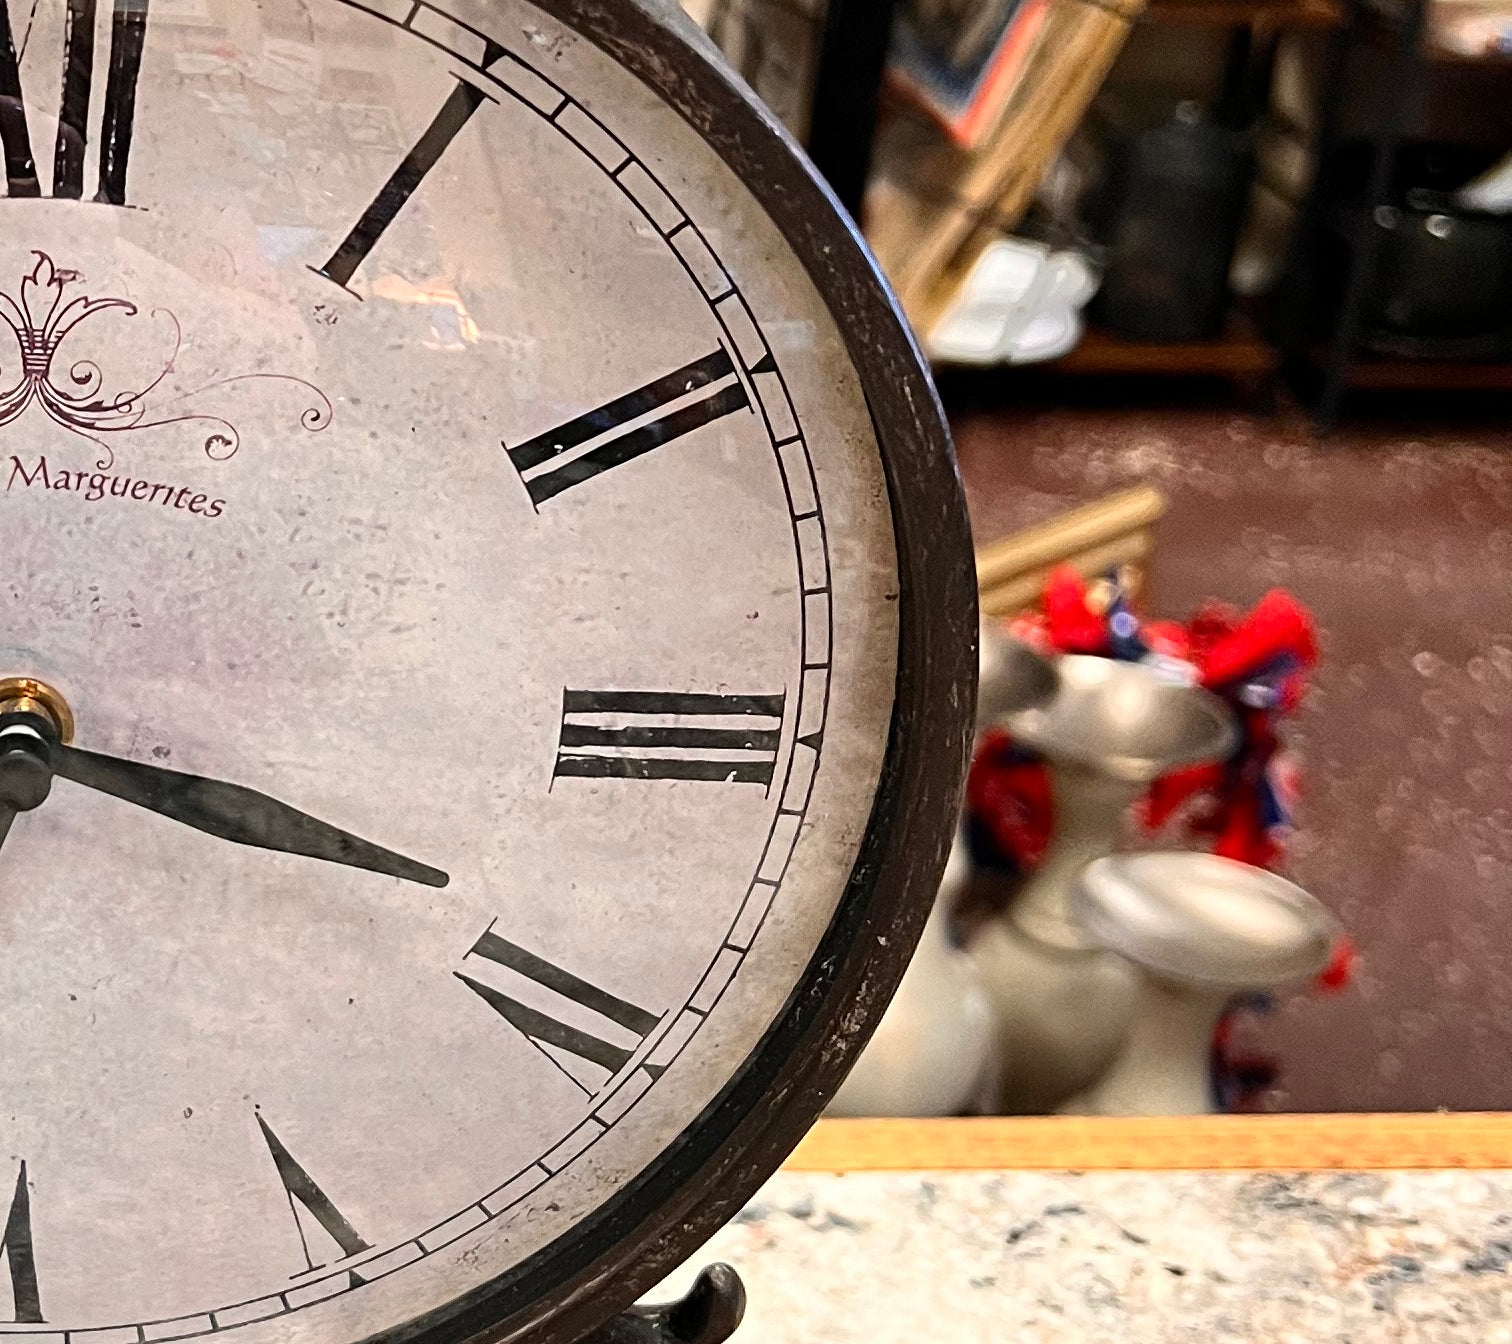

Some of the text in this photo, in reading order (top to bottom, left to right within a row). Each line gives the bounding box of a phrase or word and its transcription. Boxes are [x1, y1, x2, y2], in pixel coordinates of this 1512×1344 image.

[306, 71, 500, 301] I
[7, 455, 227, 519] Marguerites
[501, 337, 754, 514] II
